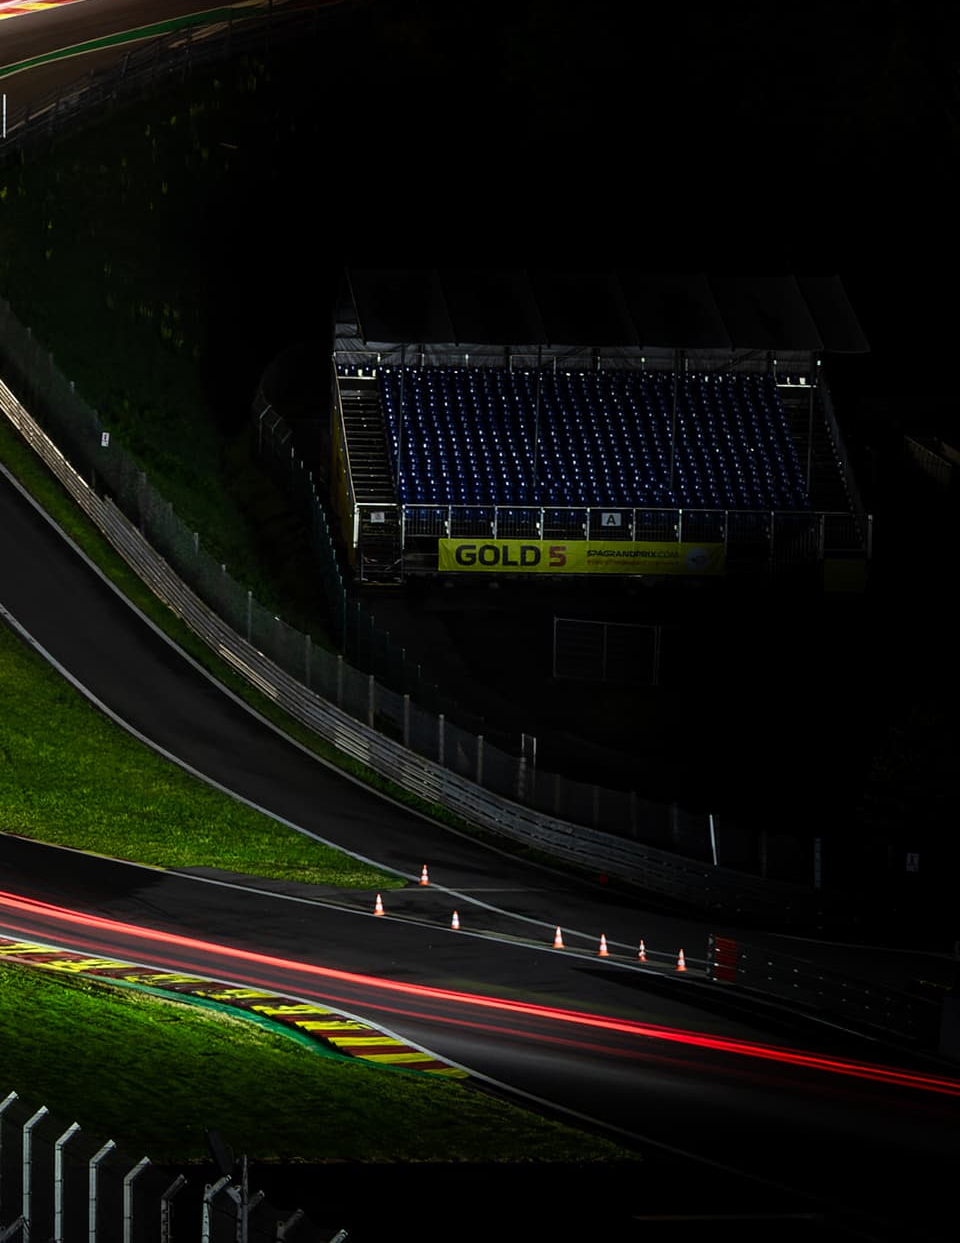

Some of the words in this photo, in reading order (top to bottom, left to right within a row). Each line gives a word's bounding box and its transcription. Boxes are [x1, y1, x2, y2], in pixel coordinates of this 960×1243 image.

[606, 514, 616, 525] A
[455, 544, 541, 566] GOLD
[548, 546, 567, 567] 5
